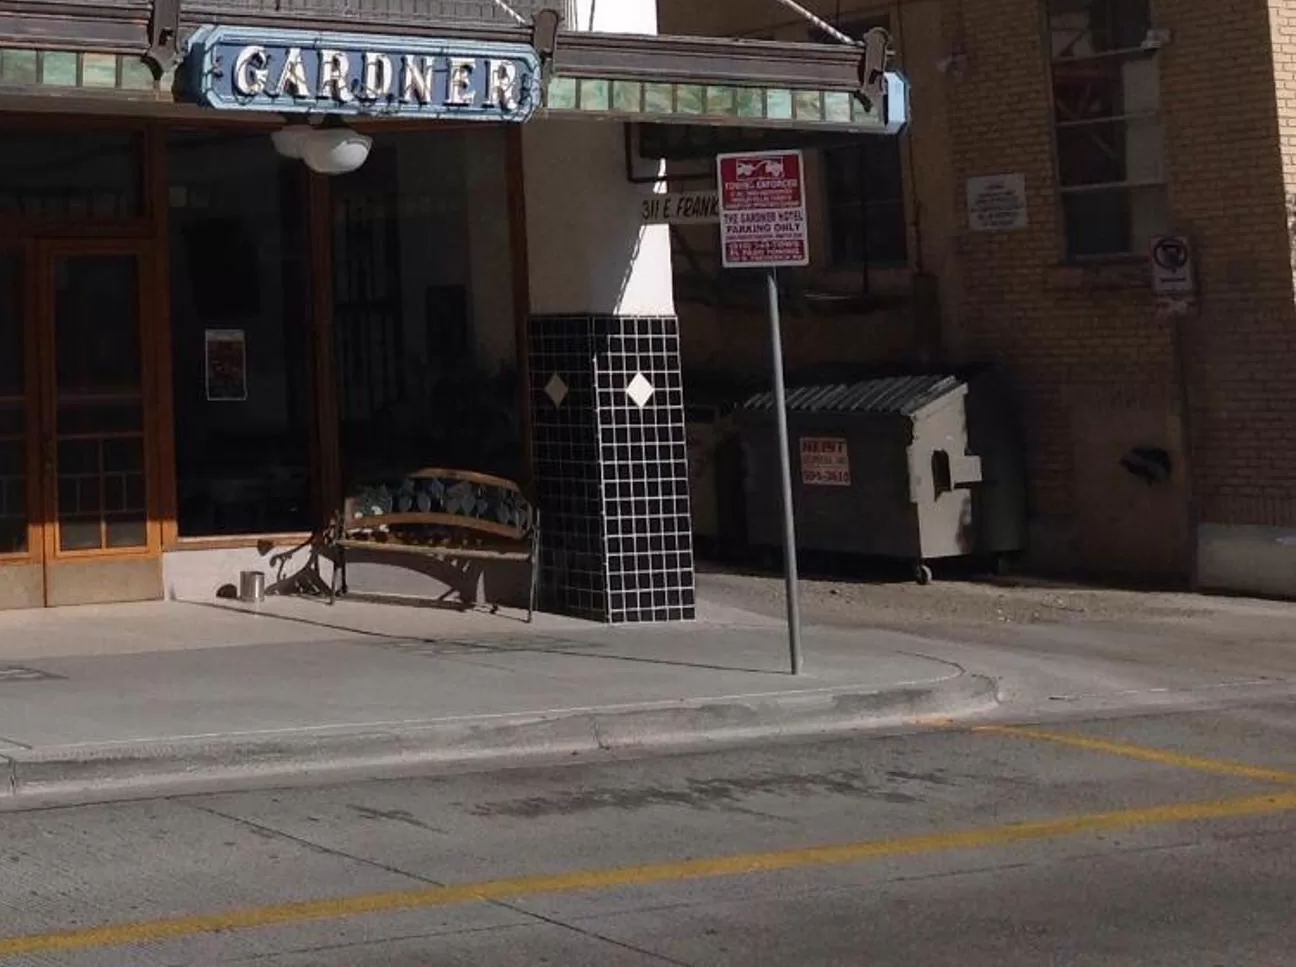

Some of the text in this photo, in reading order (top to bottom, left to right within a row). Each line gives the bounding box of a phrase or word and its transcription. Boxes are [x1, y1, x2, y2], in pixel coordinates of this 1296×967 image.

[233, 45, 518, 108] GARDNER
[641, 199, 659, 220] 311
[724, 214, 737, 224] THE
[778, 209, 802, 221] HOTEL
[726, 222, 800, 234] PARKING ONLY
